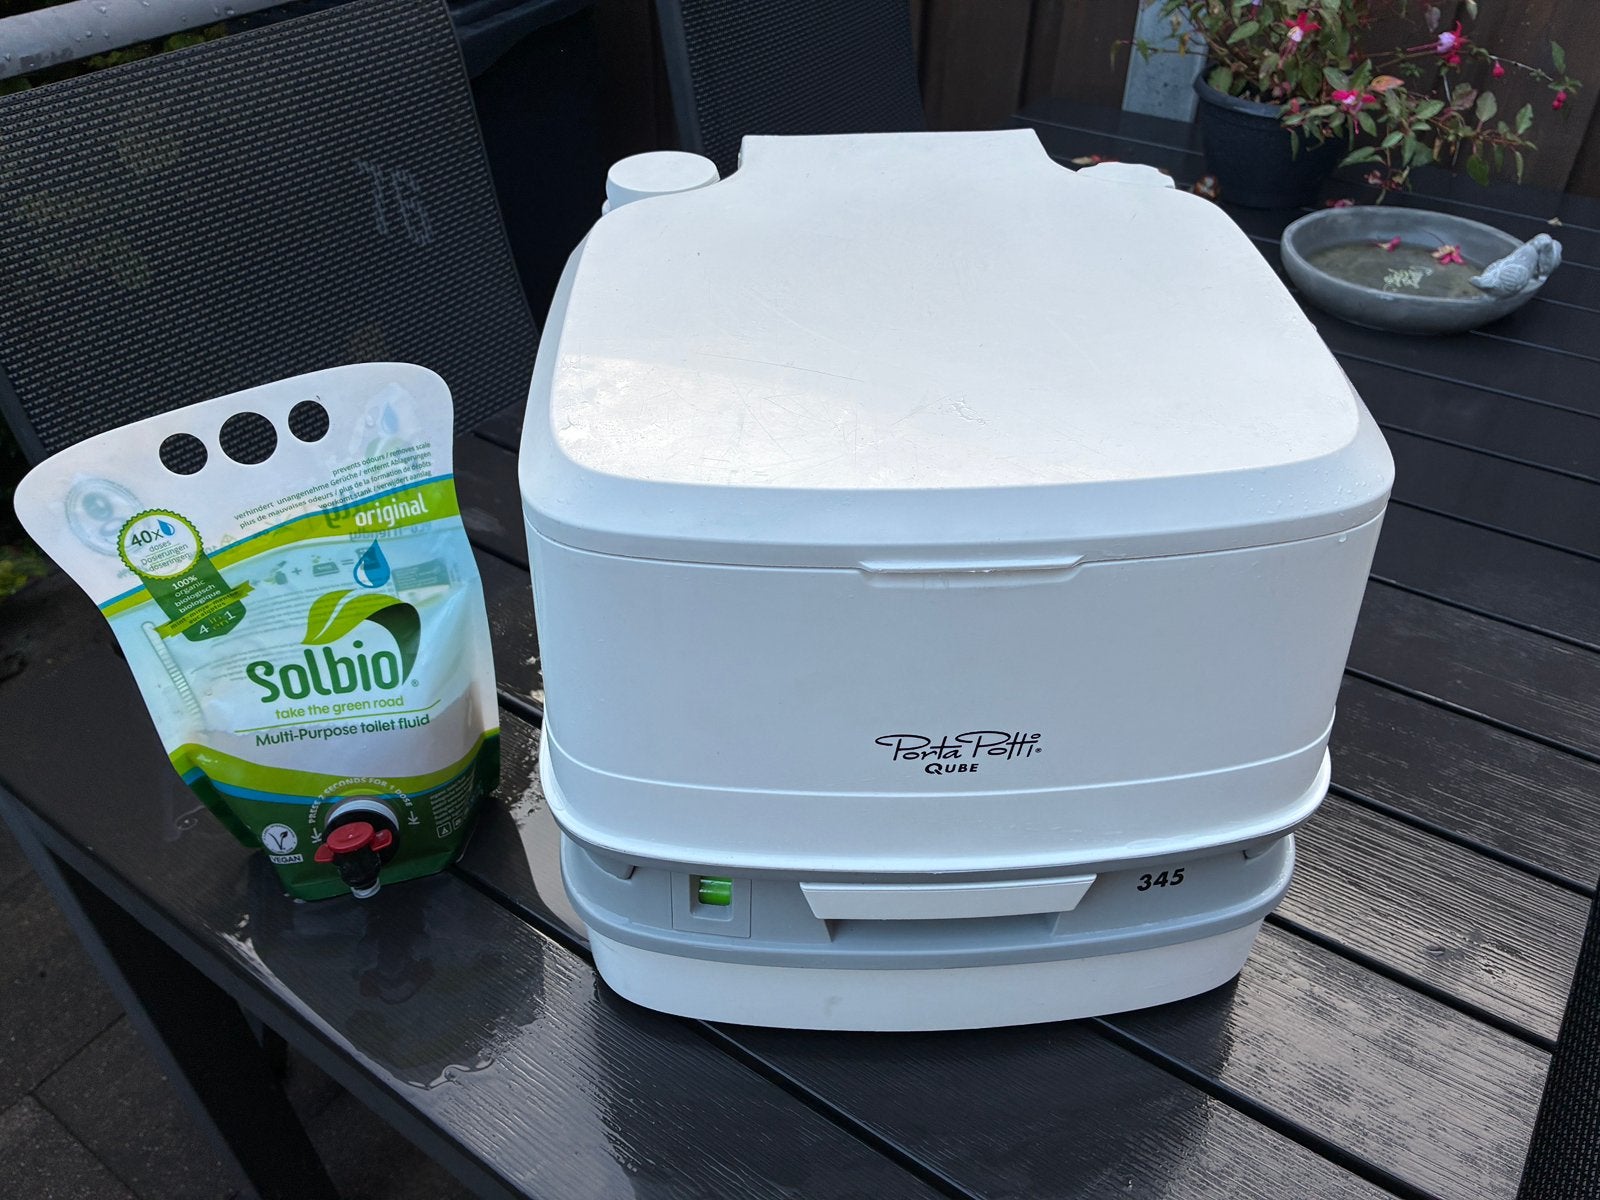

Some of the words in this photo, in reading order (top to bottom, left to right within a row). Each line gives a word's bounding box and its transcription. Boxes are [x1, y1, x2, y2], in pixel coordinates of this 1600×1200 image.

[332, 461, 361, 477] prevents
[362, 453, 386, 465] odours
[390, 446, 415, 458] removes
[416, 442, 431, 451] scale
[234, 502, 274, 520] verhindert
[277, 482, 329, 505] unangenehme
[330, 469, 358, 487] Gerüche
[363, 461, 389, 475] entfernt
[390, 451, 431, 467] Ablagerungen
[354, 487, 372, 498] stank
[377, 475, 408, 492] verwijdert
[409, 469, 432, 481] aanslag
[239, 517, 256, 529] plus
[256, 513, 267, 522] de
[268, 501, 307, 518] mauvaises
[308, 490, 334, 504] odeurs
[339, 484, 354, 498] plus
[354, 480, 363, 489] de
[364, 477, 370, 485] la
[370, 468, 402, 484] formation
[403, 465, 410, 473] de
[355, 492, 429, 527] original
[131, 529, 164, 546] 40x
[149, 540, 171, 553] doses
[141, 543, 188, 565] Dosierungen
[149, 552, 191, 572] doseringen
[172, 575, 197, 590] 100%
[174, 579, 205, 598] organic
[174, 583, 215, 608] biologisch
[179, 589, 221, 614] biologique
[199, 624, 209, 634] 4
[224, 610, 236, 620] 1
[246, 640, 399, 703] Solbio
[275, 706, 305, 720] take
[307, 703, 330, 716] the
[332, 700, 371, 716] green
[373, 696, 404, 708] road
[256, 724, 358, 747] Multi-Purpose
[361, 716, 395, 733] toilet
[397, 714, 430, 731] fluid
[875, 734, 963, 761] Porta
[955, 730, 1041, 760] Potti
[924, 762, 980, 775] QUBE
[308, 799, 321, 824] PRESS
[324, 777, 367, 794] SECONDS
[368, 778, 388, 787] FOR
[395, 788, 413, 807] DOSE
[271, 855, 301, 864] VEGAN
[1137, 867, 1185, 891] 345
